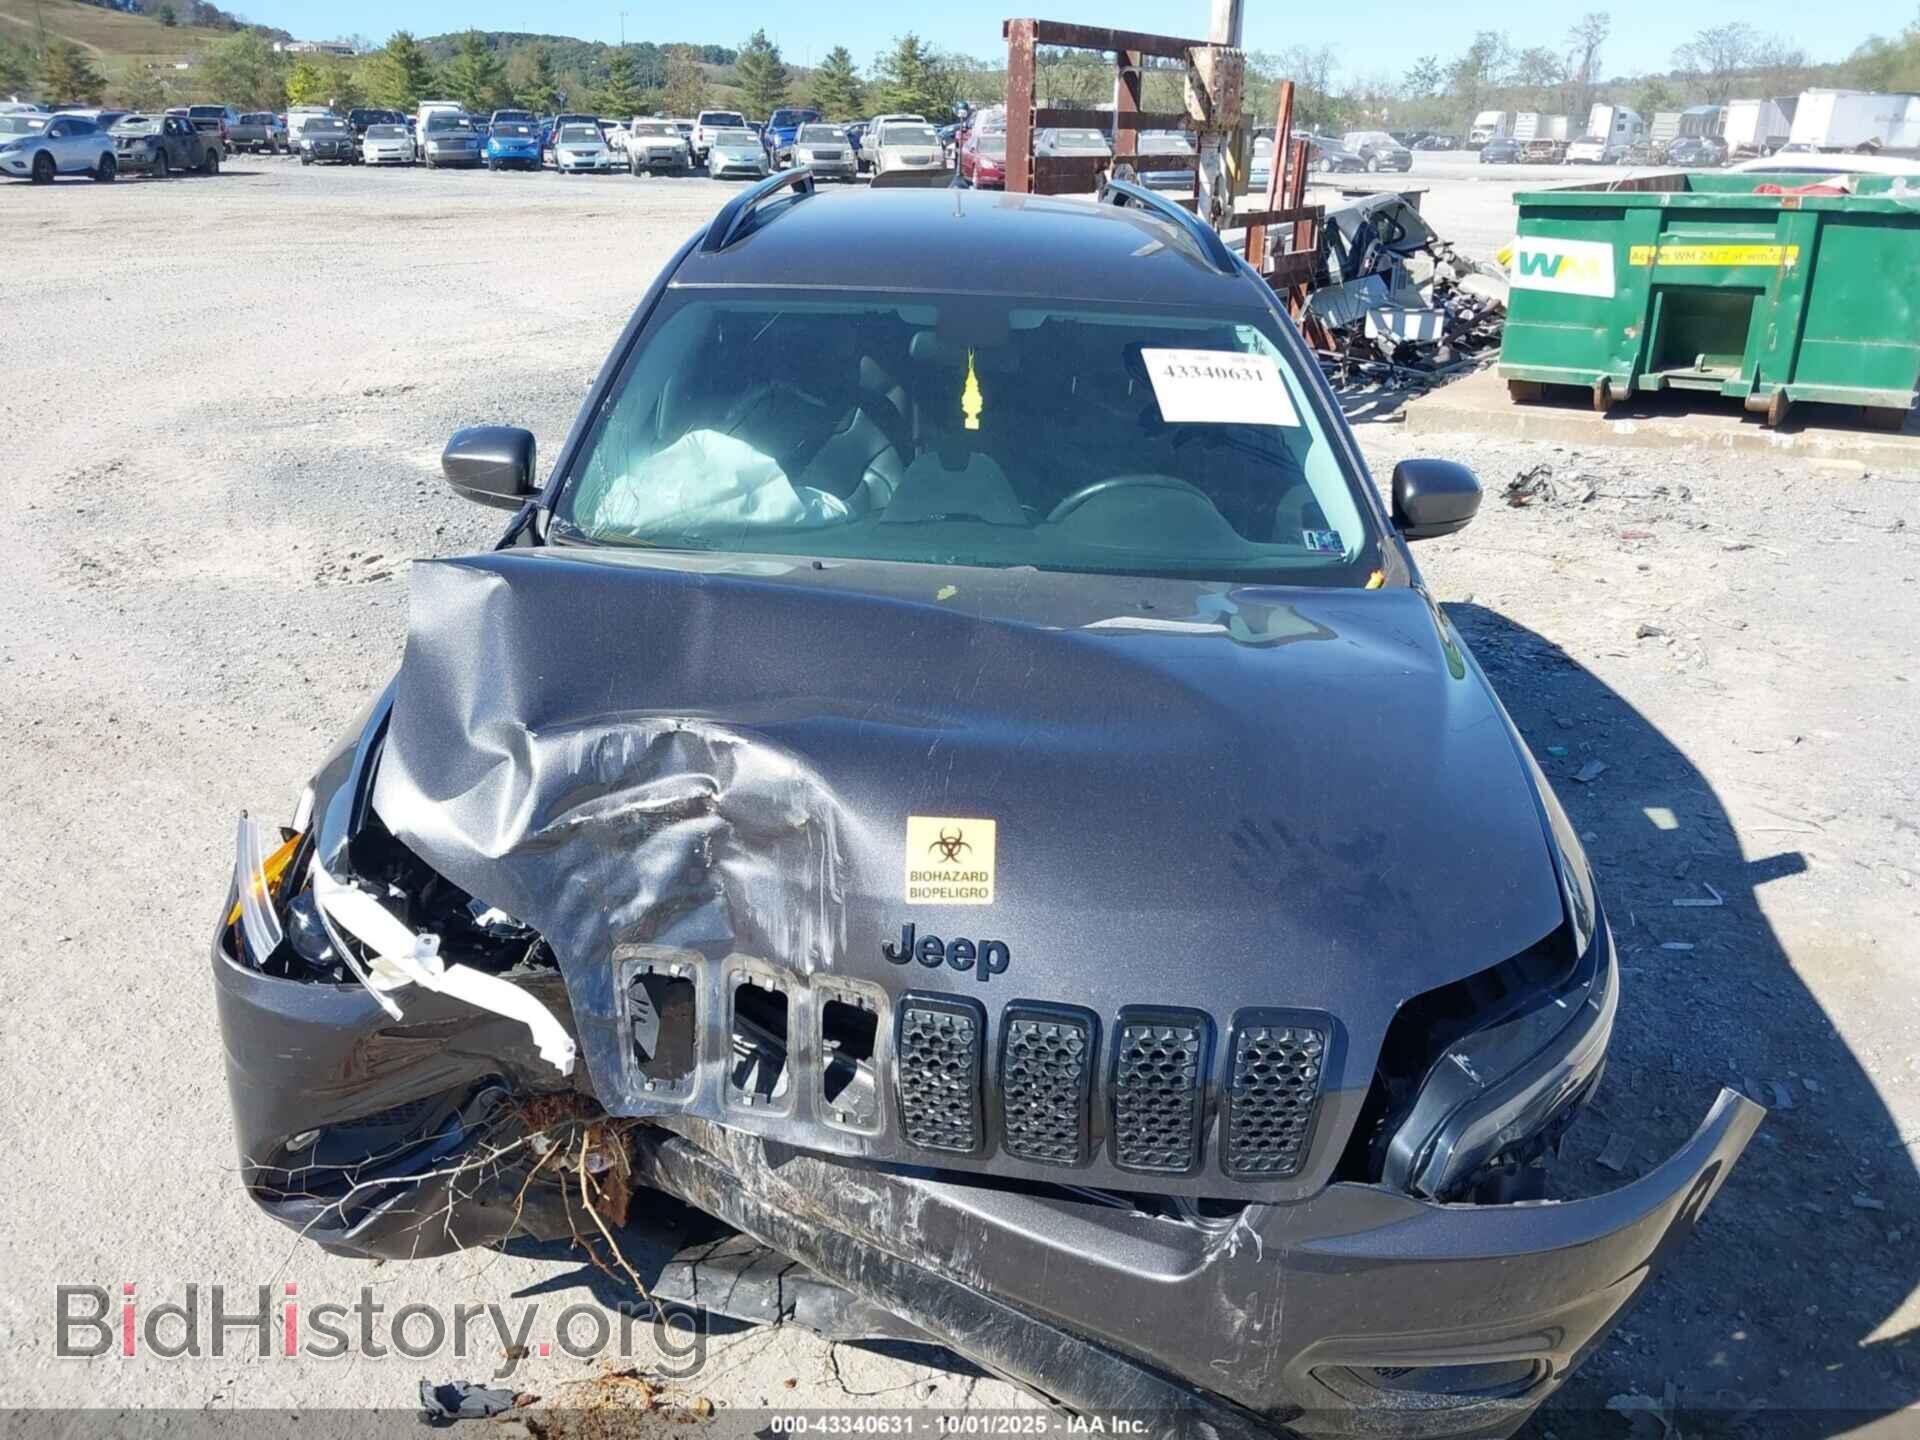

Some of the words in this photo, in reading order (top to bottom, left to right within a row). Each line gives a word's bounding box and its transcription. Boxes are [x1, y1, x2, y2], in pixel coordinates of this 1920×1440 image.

[1674, 251, 1696, 262] WM
[1519, 251, 1601, 281] WM
[1163, 365, 1263, 382] 43340631
[910, 871, 989, 882] BIOHAZARD
[910, 887, 989, 898] BIOPELIGRO
[882, 922, 1010, 982] Jeep
